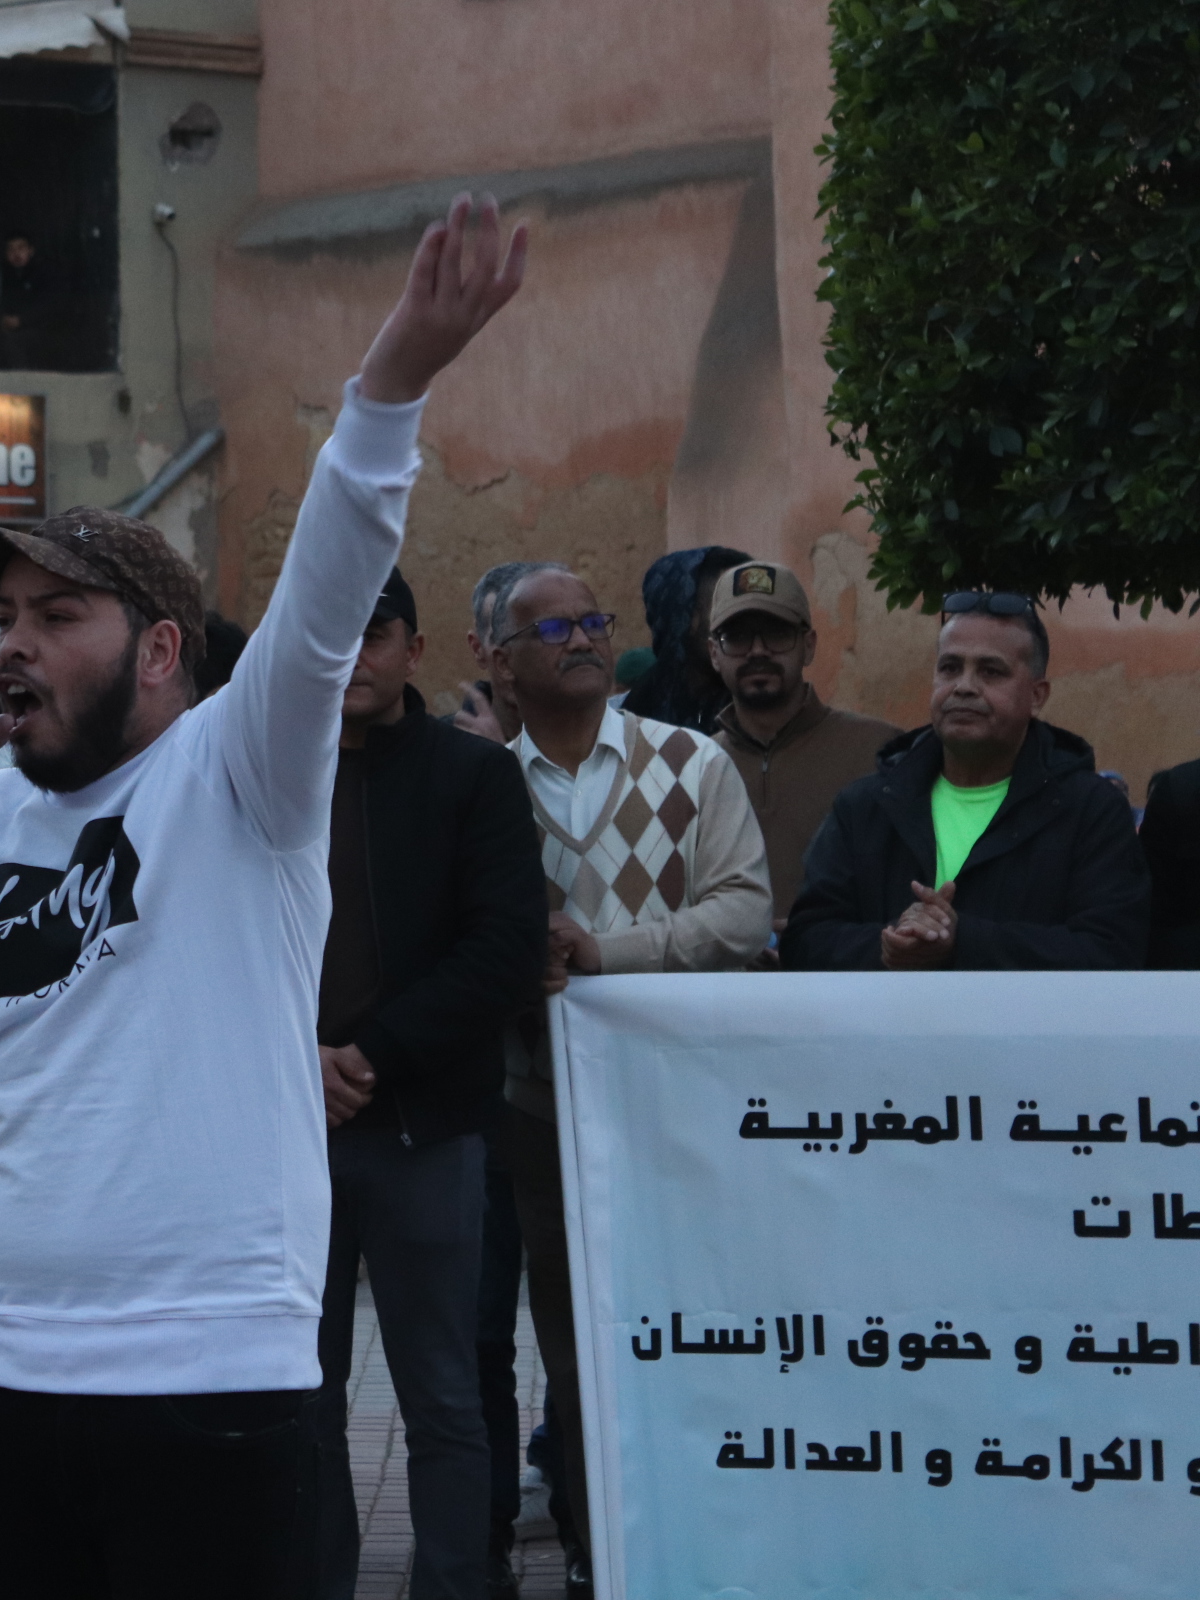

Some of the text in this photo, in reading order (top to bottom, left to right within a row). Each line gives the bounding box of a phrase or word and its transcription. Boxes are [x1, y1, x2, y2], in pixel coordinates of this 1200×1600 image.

[738, 1095, 983, 1155] المغربية
[631, 1311, 826, 1374] الإنسان
[847, 1316, 991, 1372] حقوق
[1014, 1335, 1043, 1375] و
[716, 1427, 903, 1474] العدالة
[924, 1448, 953, 1488] و
[974, 1436, 1164, 1493] الكرامة
